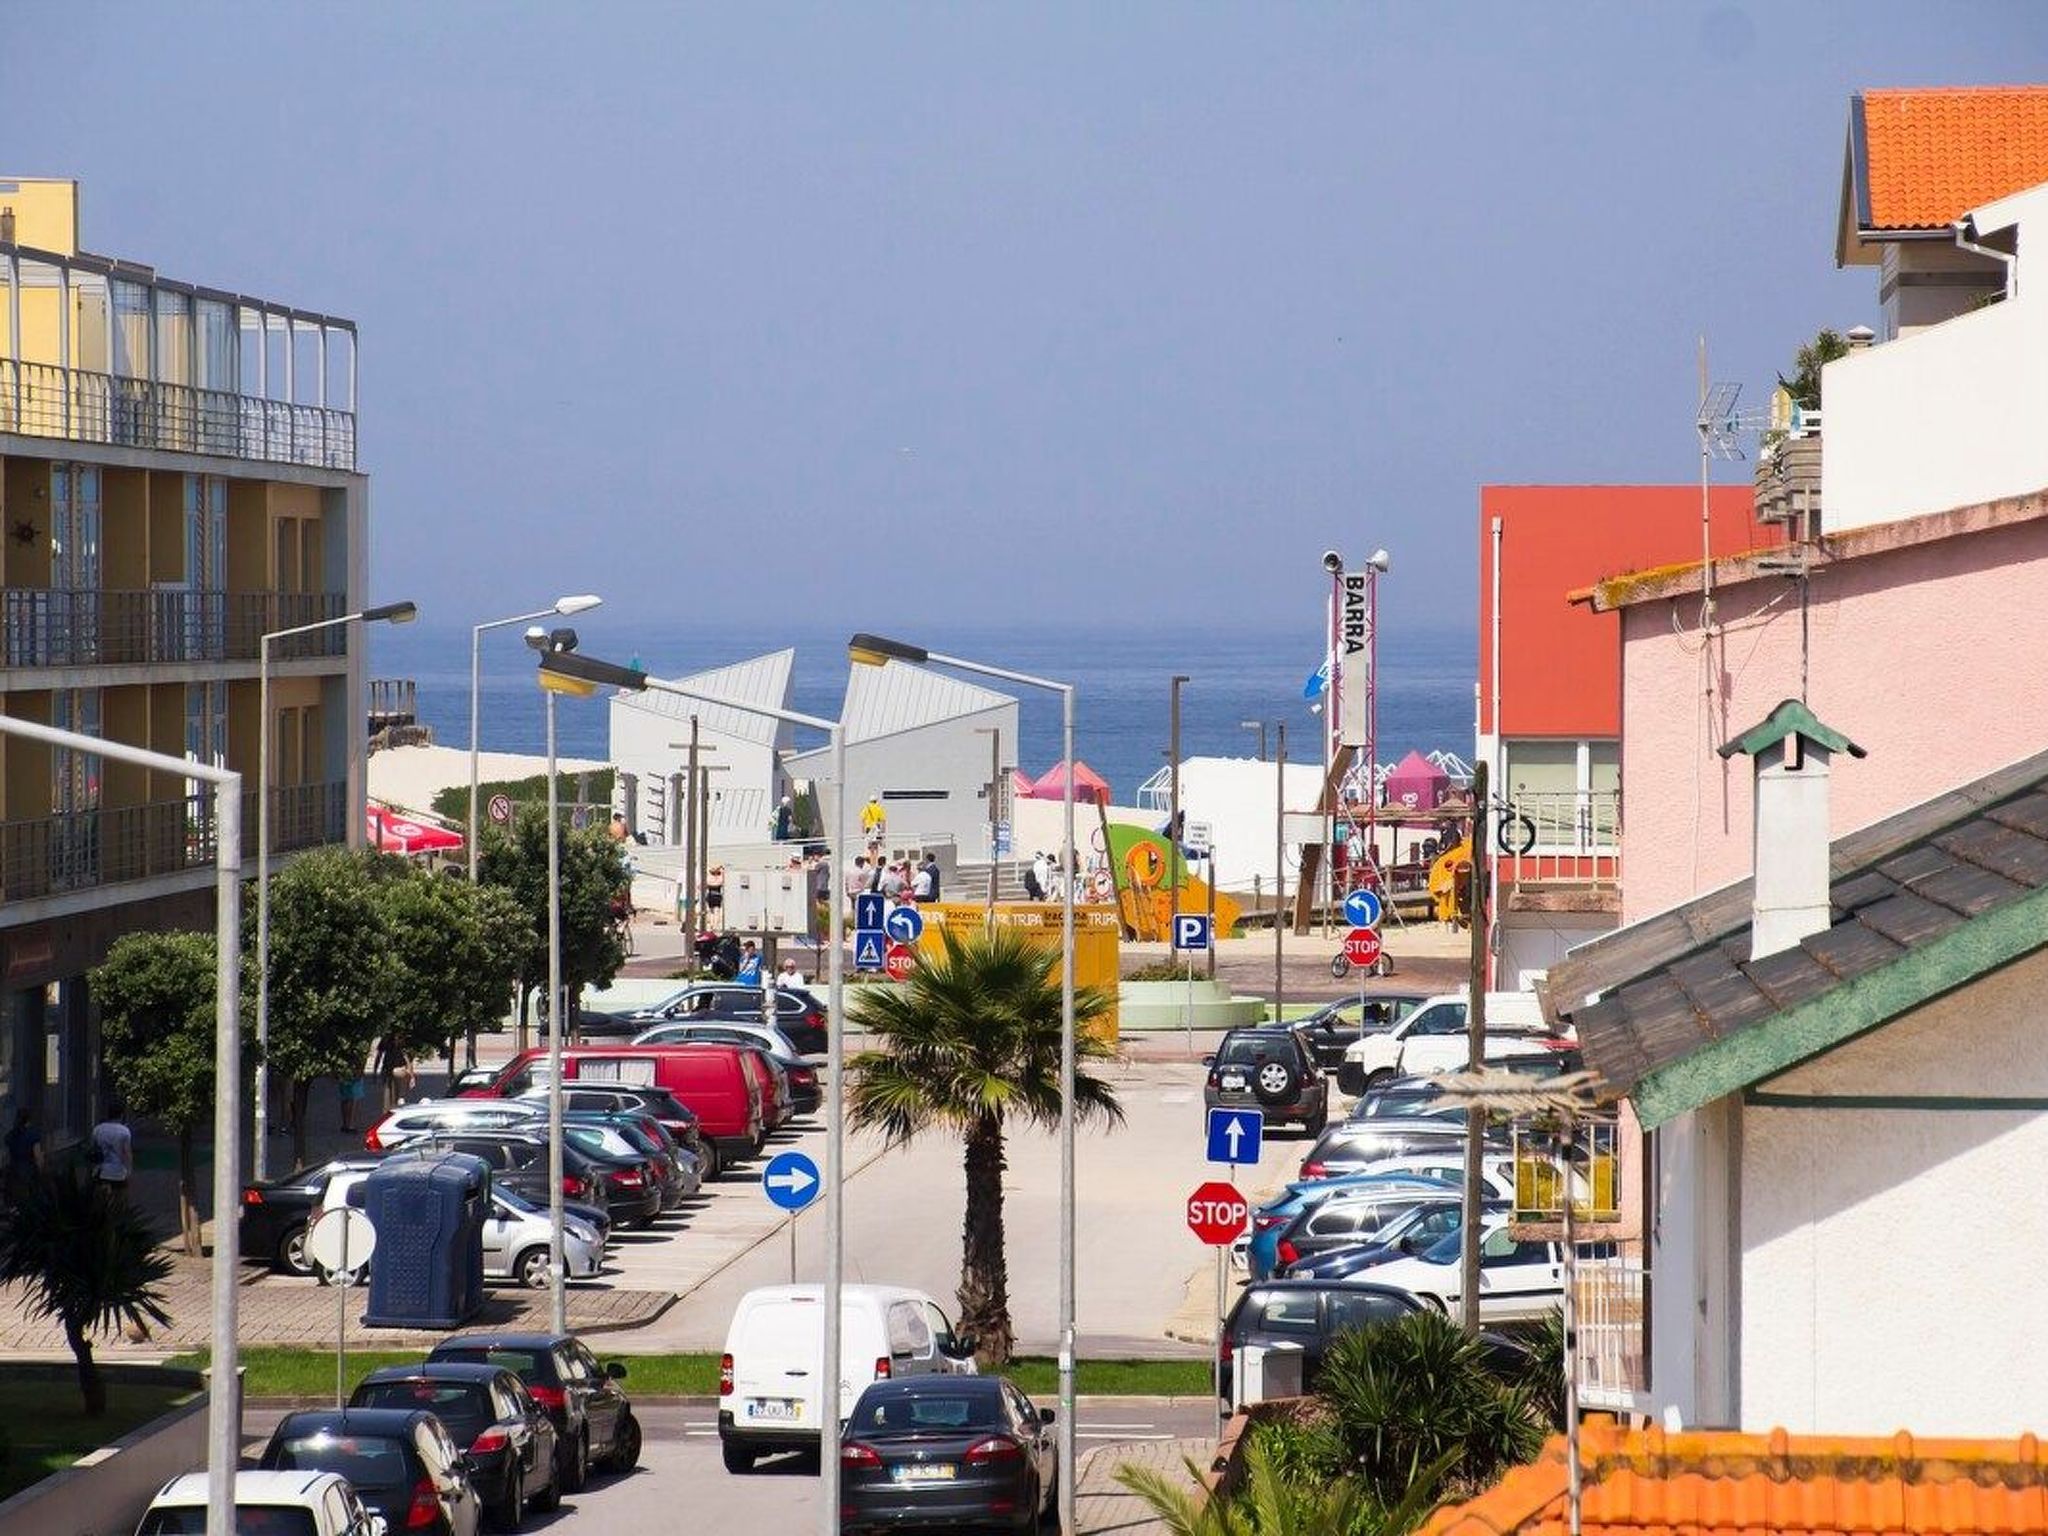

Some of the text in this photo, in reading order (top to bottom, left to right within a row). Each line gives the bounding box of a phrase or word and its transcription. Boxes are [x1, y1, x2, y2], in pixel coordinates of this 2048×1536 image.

[1345, 577, 1364, 654] BARRA
[1180, 918, 1202, 946] P
[1346, 940, 1379, 954] STOP
[889, 956, 914, 969] STO
[1189, 1201, 1246, 1226] STOP
